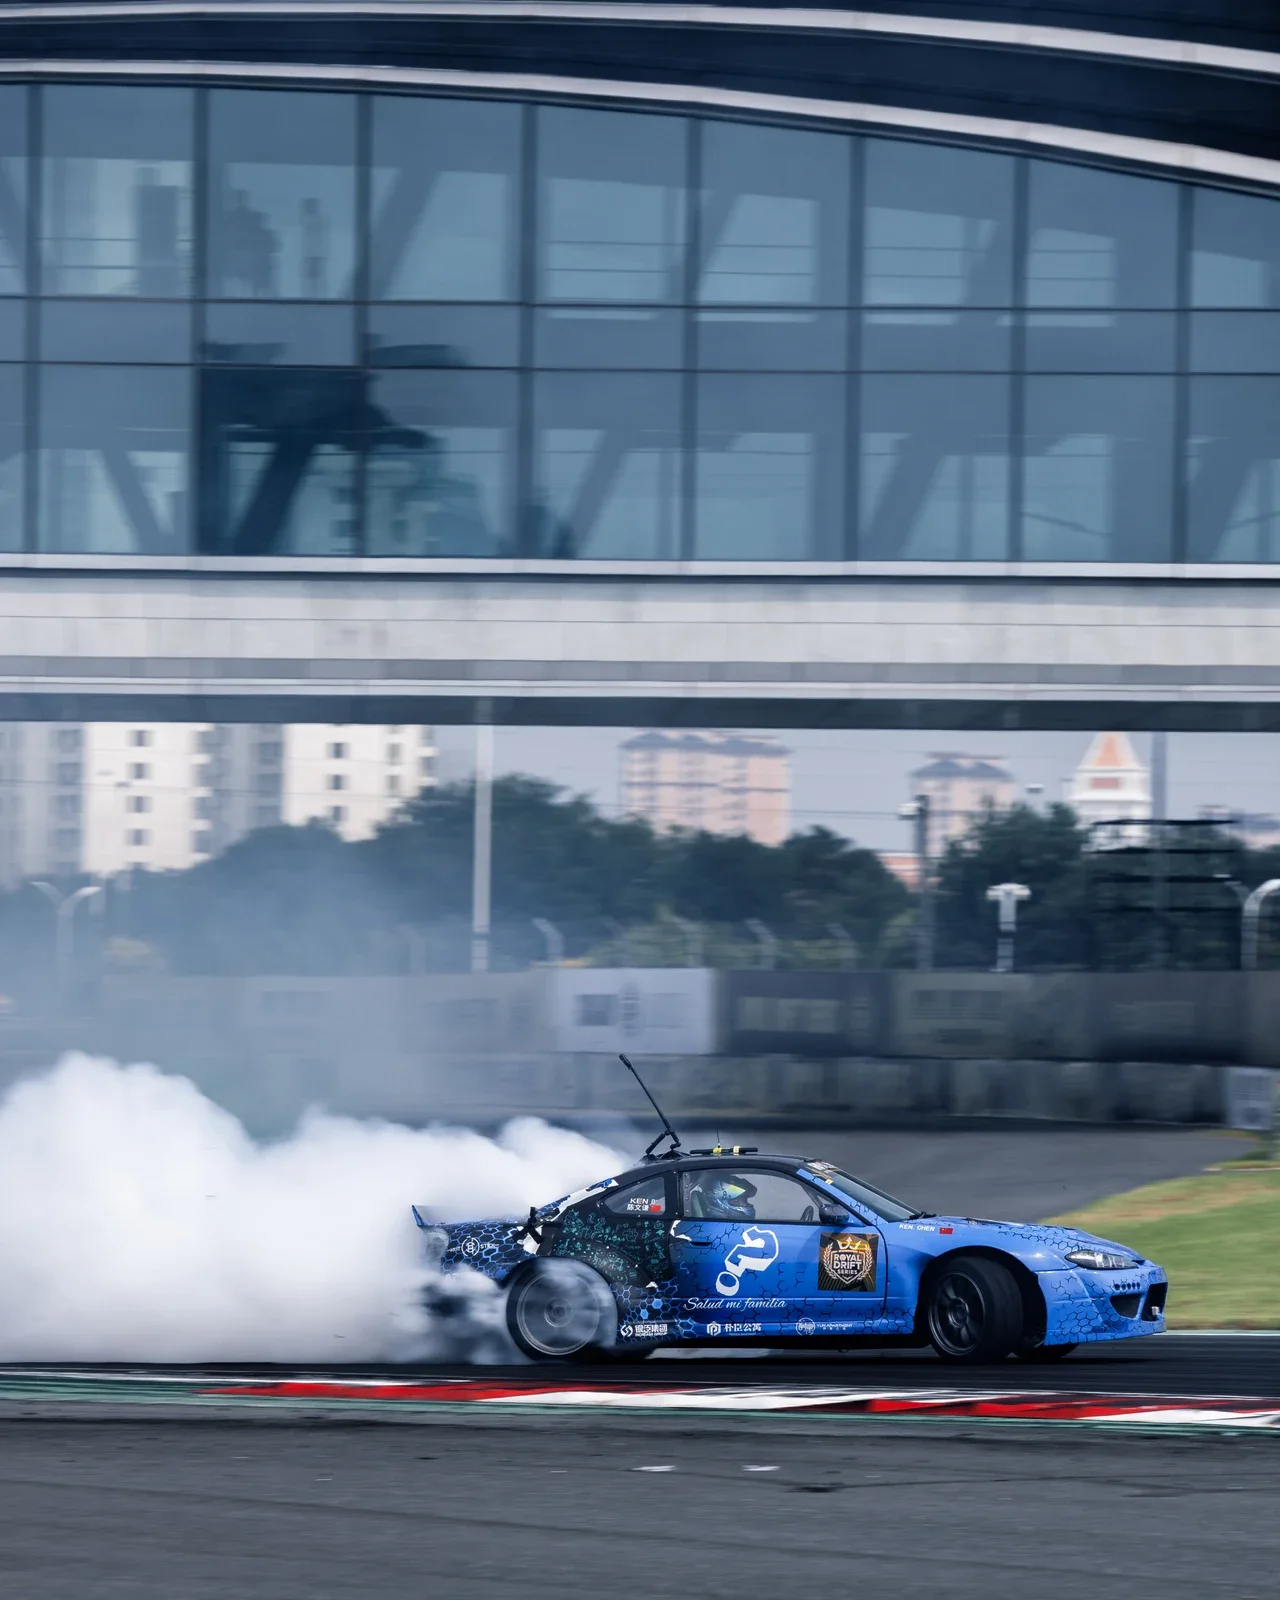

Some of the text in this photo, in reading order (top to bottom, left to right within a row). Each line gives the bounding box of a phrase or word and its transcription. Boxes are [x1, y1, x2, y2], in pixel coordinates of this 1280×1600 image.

[630, 1197, 649, 1205] KEN
[834, 1254, 862, 1262] ROYAL
[833, 1261, 862, 1270] DRIFT
[683, 1297, 787, 1312] Salud mi familia
